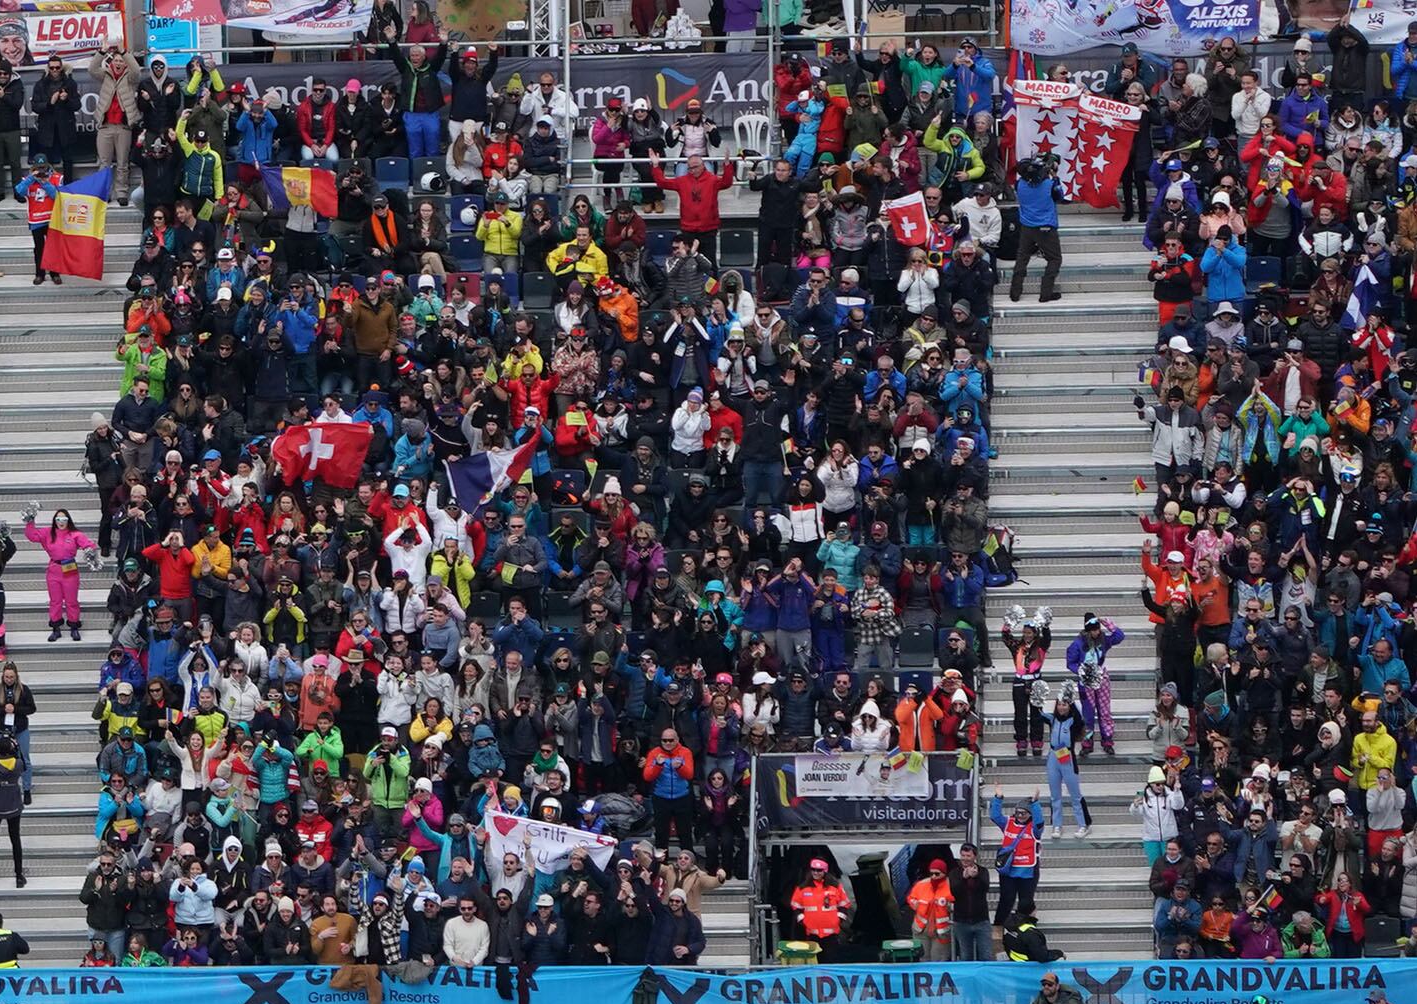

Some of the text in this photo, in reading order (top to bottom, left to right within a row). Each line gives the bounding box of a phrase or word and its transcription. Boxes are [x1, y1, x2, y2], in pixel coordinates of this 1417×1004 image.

[1187, 5, 1249, 20] ALEXIS
[36, 16, 109, 41] LEONA
[1189, 18, 1253, 29] PINTURAULT
[1025, 82, 1070, 94] MARCO
[1088, 98, 1131, 116] MARCO
[1142, 964, 1387, 992] GRANDVALIRA
[389, 989, 441, 1004] Resorts
